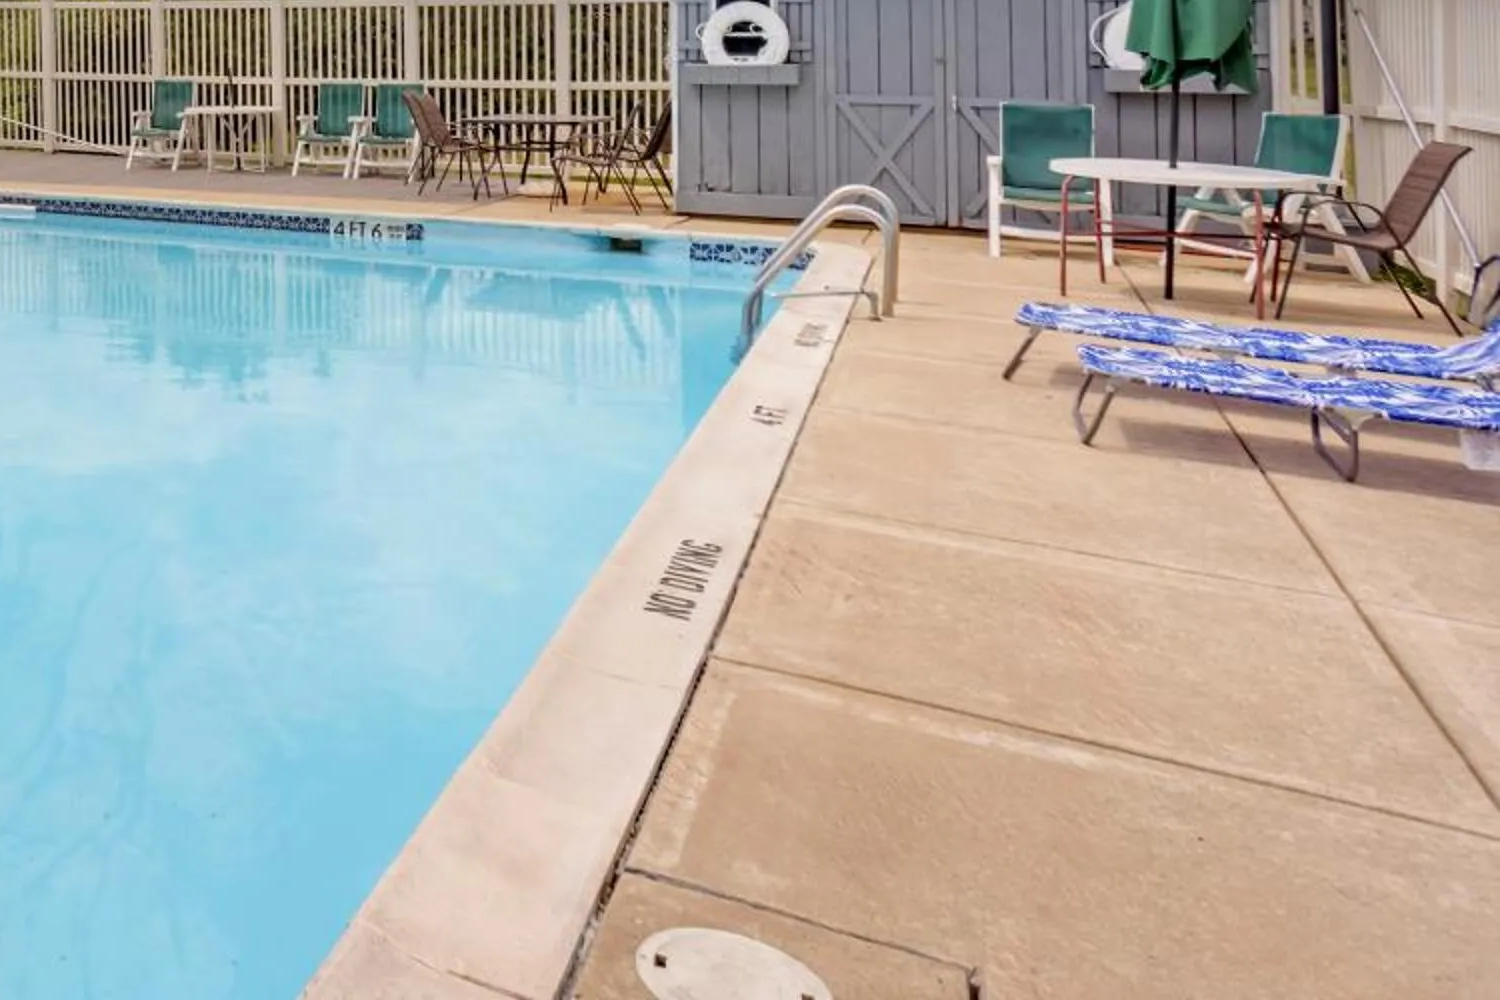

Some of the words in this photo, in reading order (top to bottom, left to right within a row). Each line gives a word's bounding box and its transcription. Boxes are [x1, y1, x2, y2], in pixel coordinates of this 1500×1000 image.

[333, 220, 345, 235] 4
[349, 220, 367, 238] FT
[371, 222, 383, 238] 6
[659, 538, 723, 593] DIVING
[642, 592, 697, 622] NO
